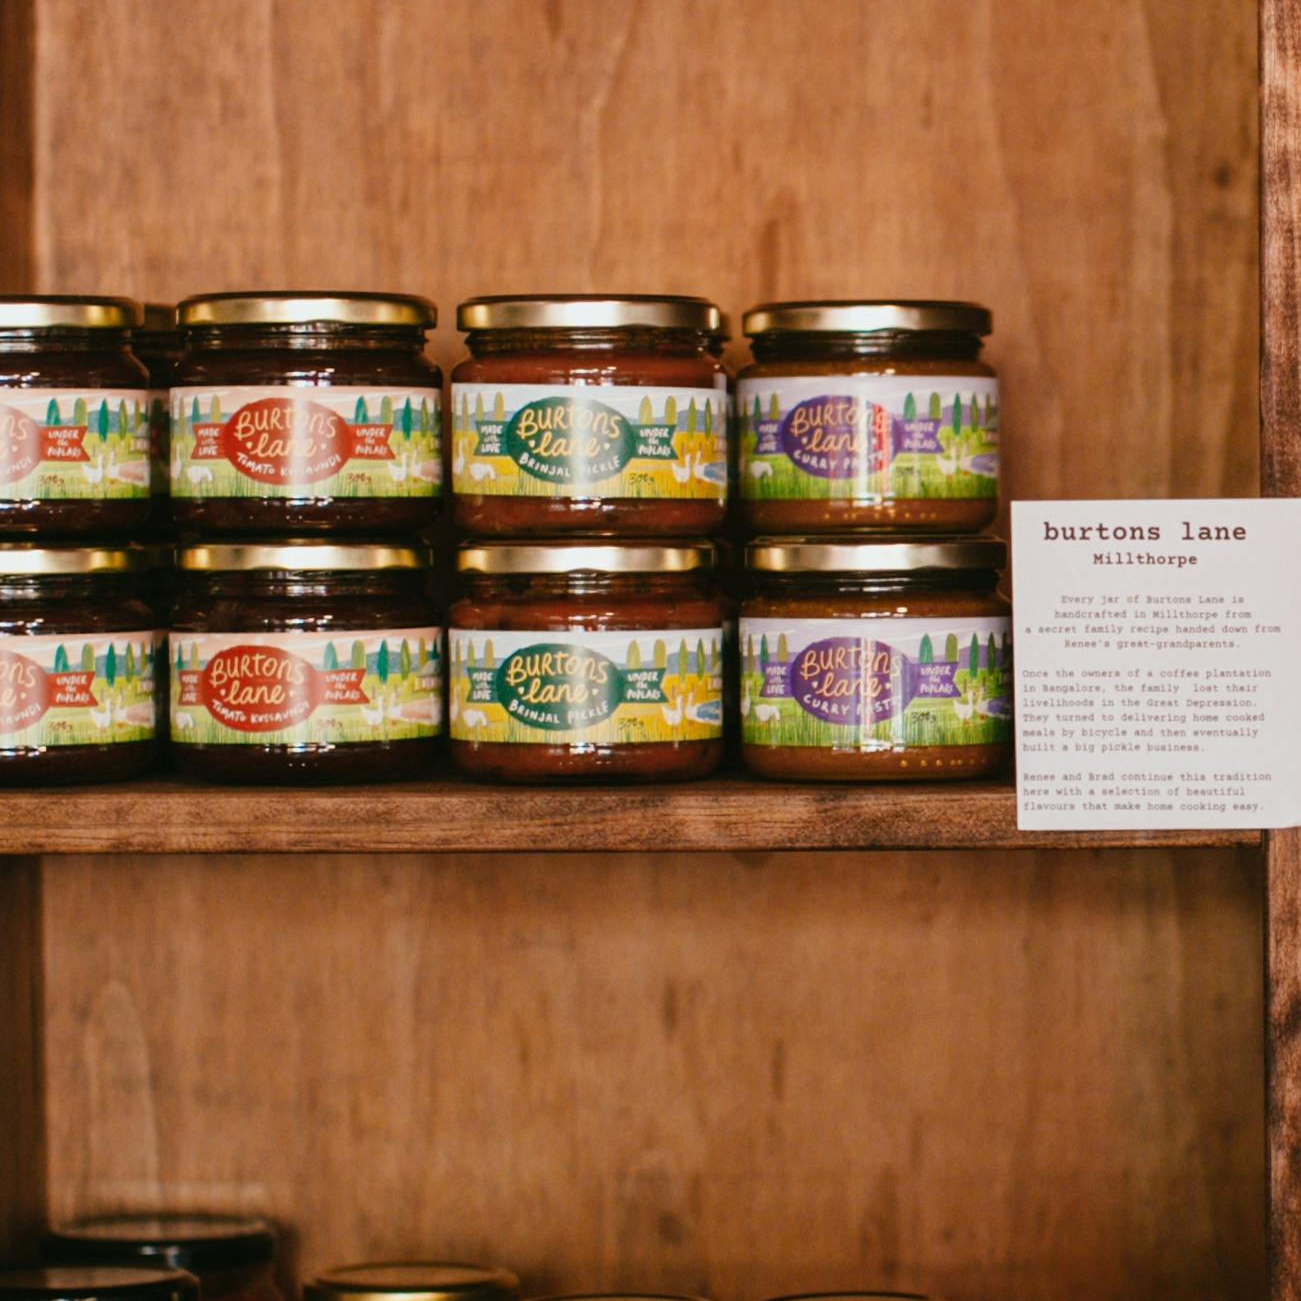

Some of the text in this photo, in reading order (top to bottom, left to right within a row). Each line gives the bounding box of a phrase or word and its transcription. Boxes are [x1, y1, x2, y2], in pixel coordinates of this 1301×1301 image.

[250, 434, 317, 458] lane
[534, 433, 599, 457] lane
[237, 452, 275, 475] TOMATO
[519, 453, 620, 477] BRINJAL ICKLE
[794, 451, 838, 468] CURRY
[1043, 521, 1247, 541] burtons lane
[1092, 552, 1198, 567] Millthorpe
[1060, 594, 1245, 607] Every jar of Burtons Lane is
[225, 683, 285, 705] lane
[523, 678, 588, 703] lane
[817, 674, 881, 698] lane
[212, 699, 246, 722] TOMATO
[510, 699, 608, 724] BRINJAL PICKLE
[803, 694, 849, 715] CURRY
